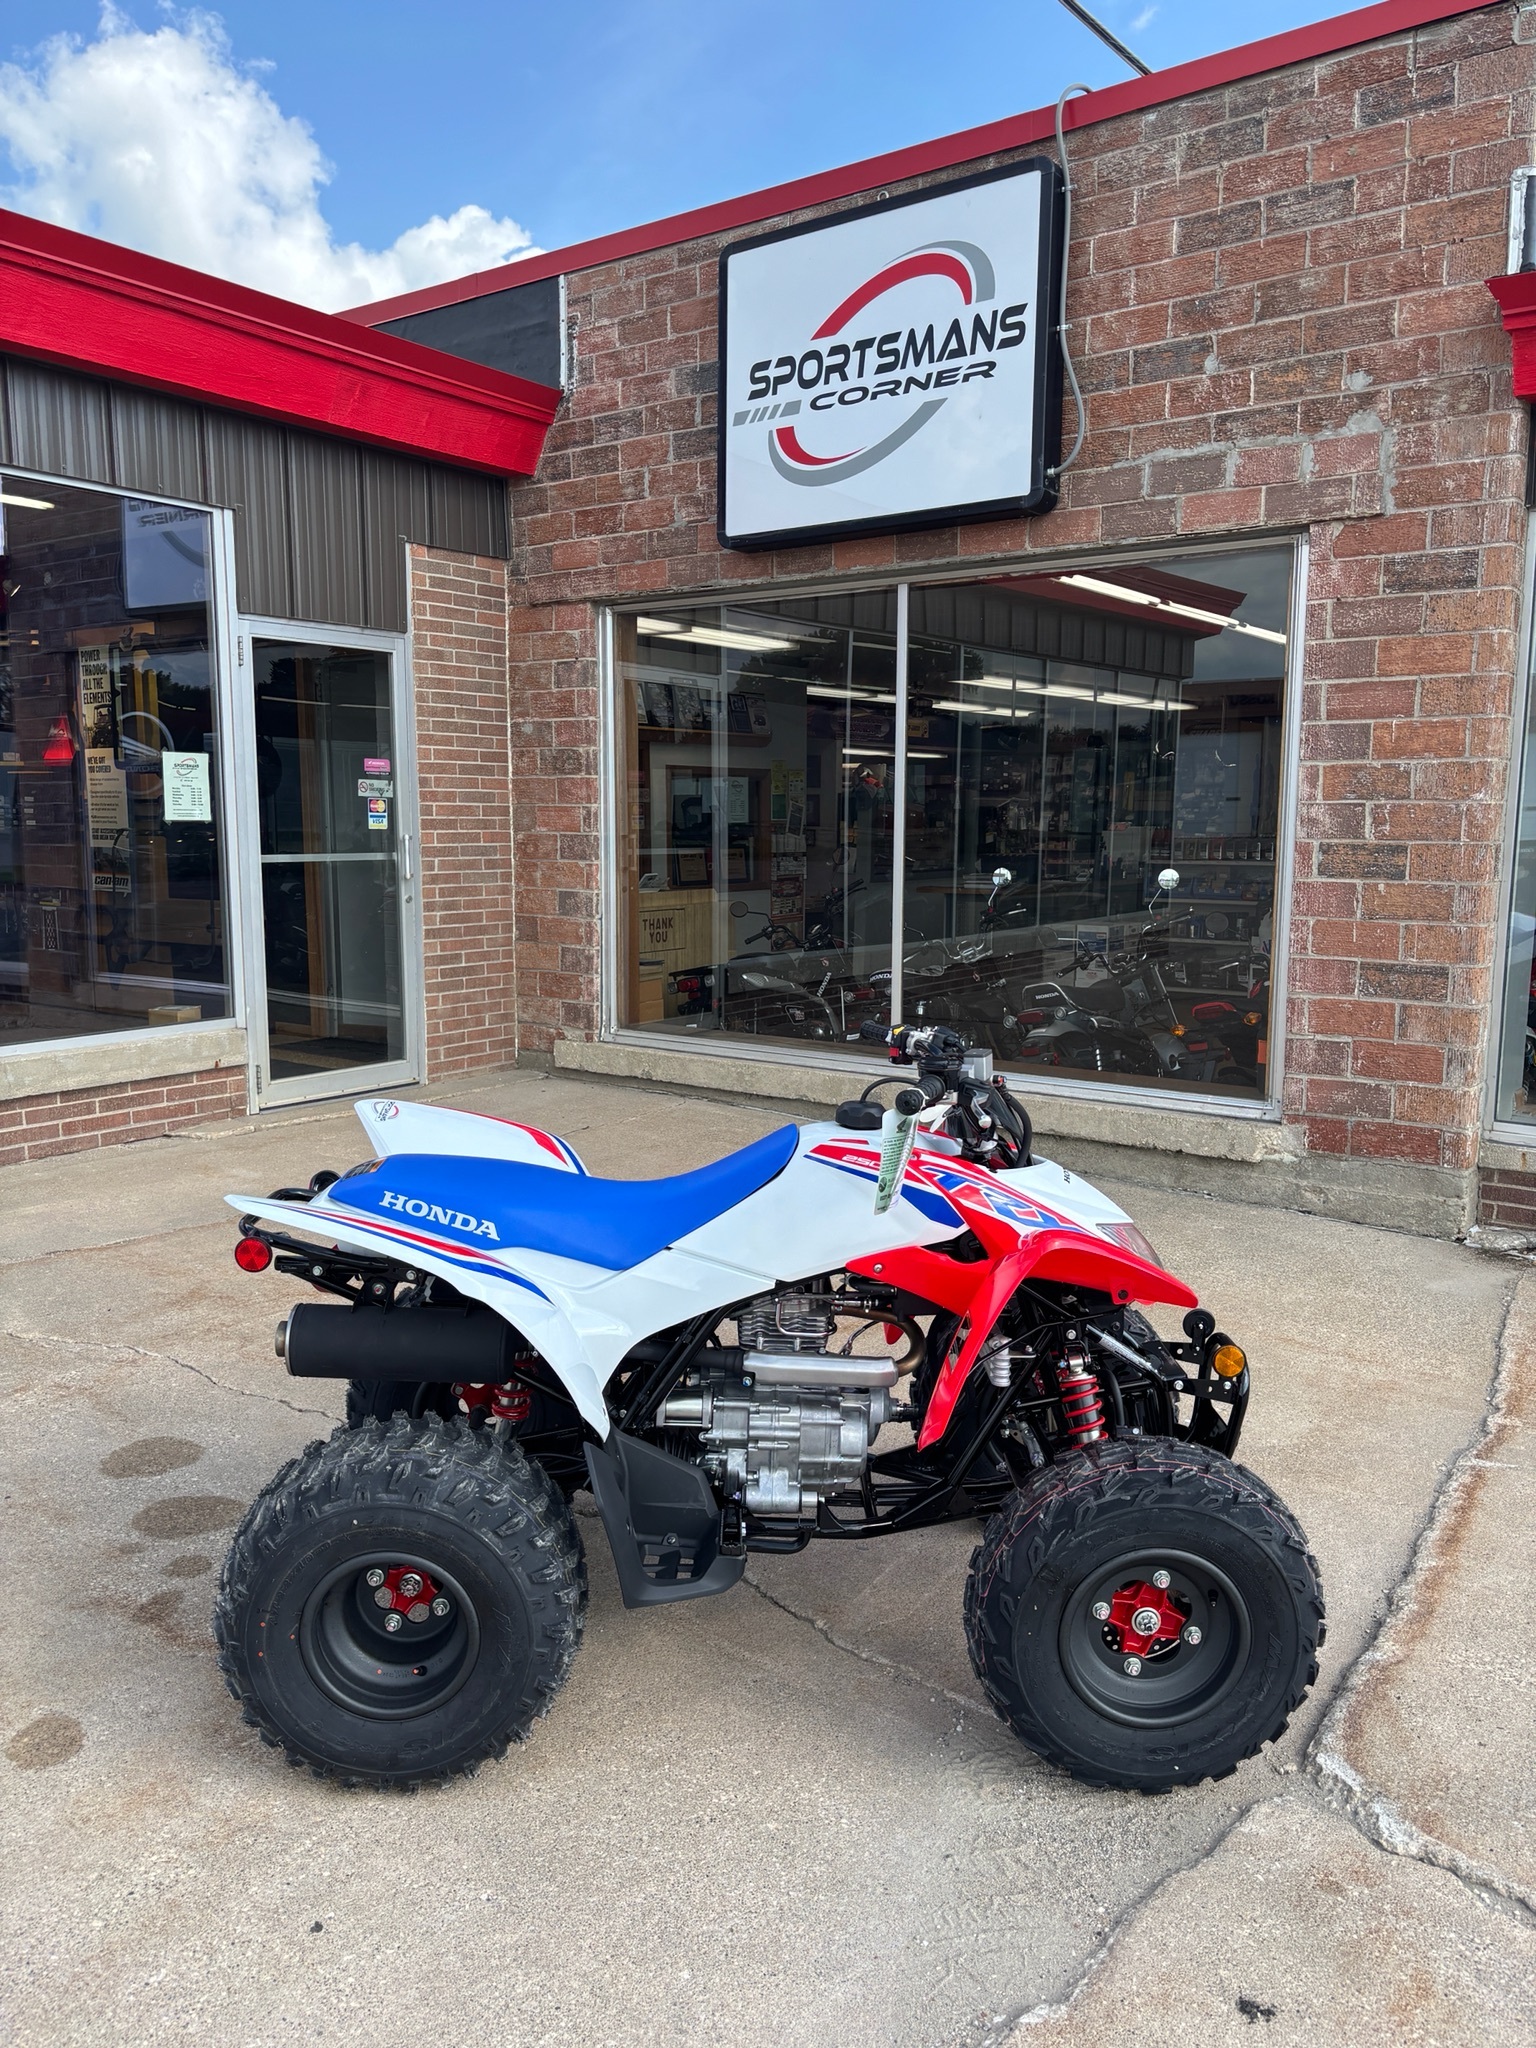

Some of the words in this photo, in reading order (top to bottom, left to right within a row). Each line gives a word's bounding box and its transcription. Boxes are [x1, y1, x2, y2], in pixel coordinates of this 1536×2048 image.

[747, 302, 1029, 401] SPORTSMANS
[809, 360, 998, 411] CORNER
[81, 649, 101, 663] POWER
[83, 678, 93, 691] ALL
[93, 677, 104, 690] THE
[83, 692, 112, 705] ELEMENTS
[642, 916, 674, 931] THANK
[649, 930, 668, 944] YOU
[816, 971, 832, 997] HONDA
[1035, 991, 1060, 1000] HONDA
[379, 1190, 500, 1241] HONDA
